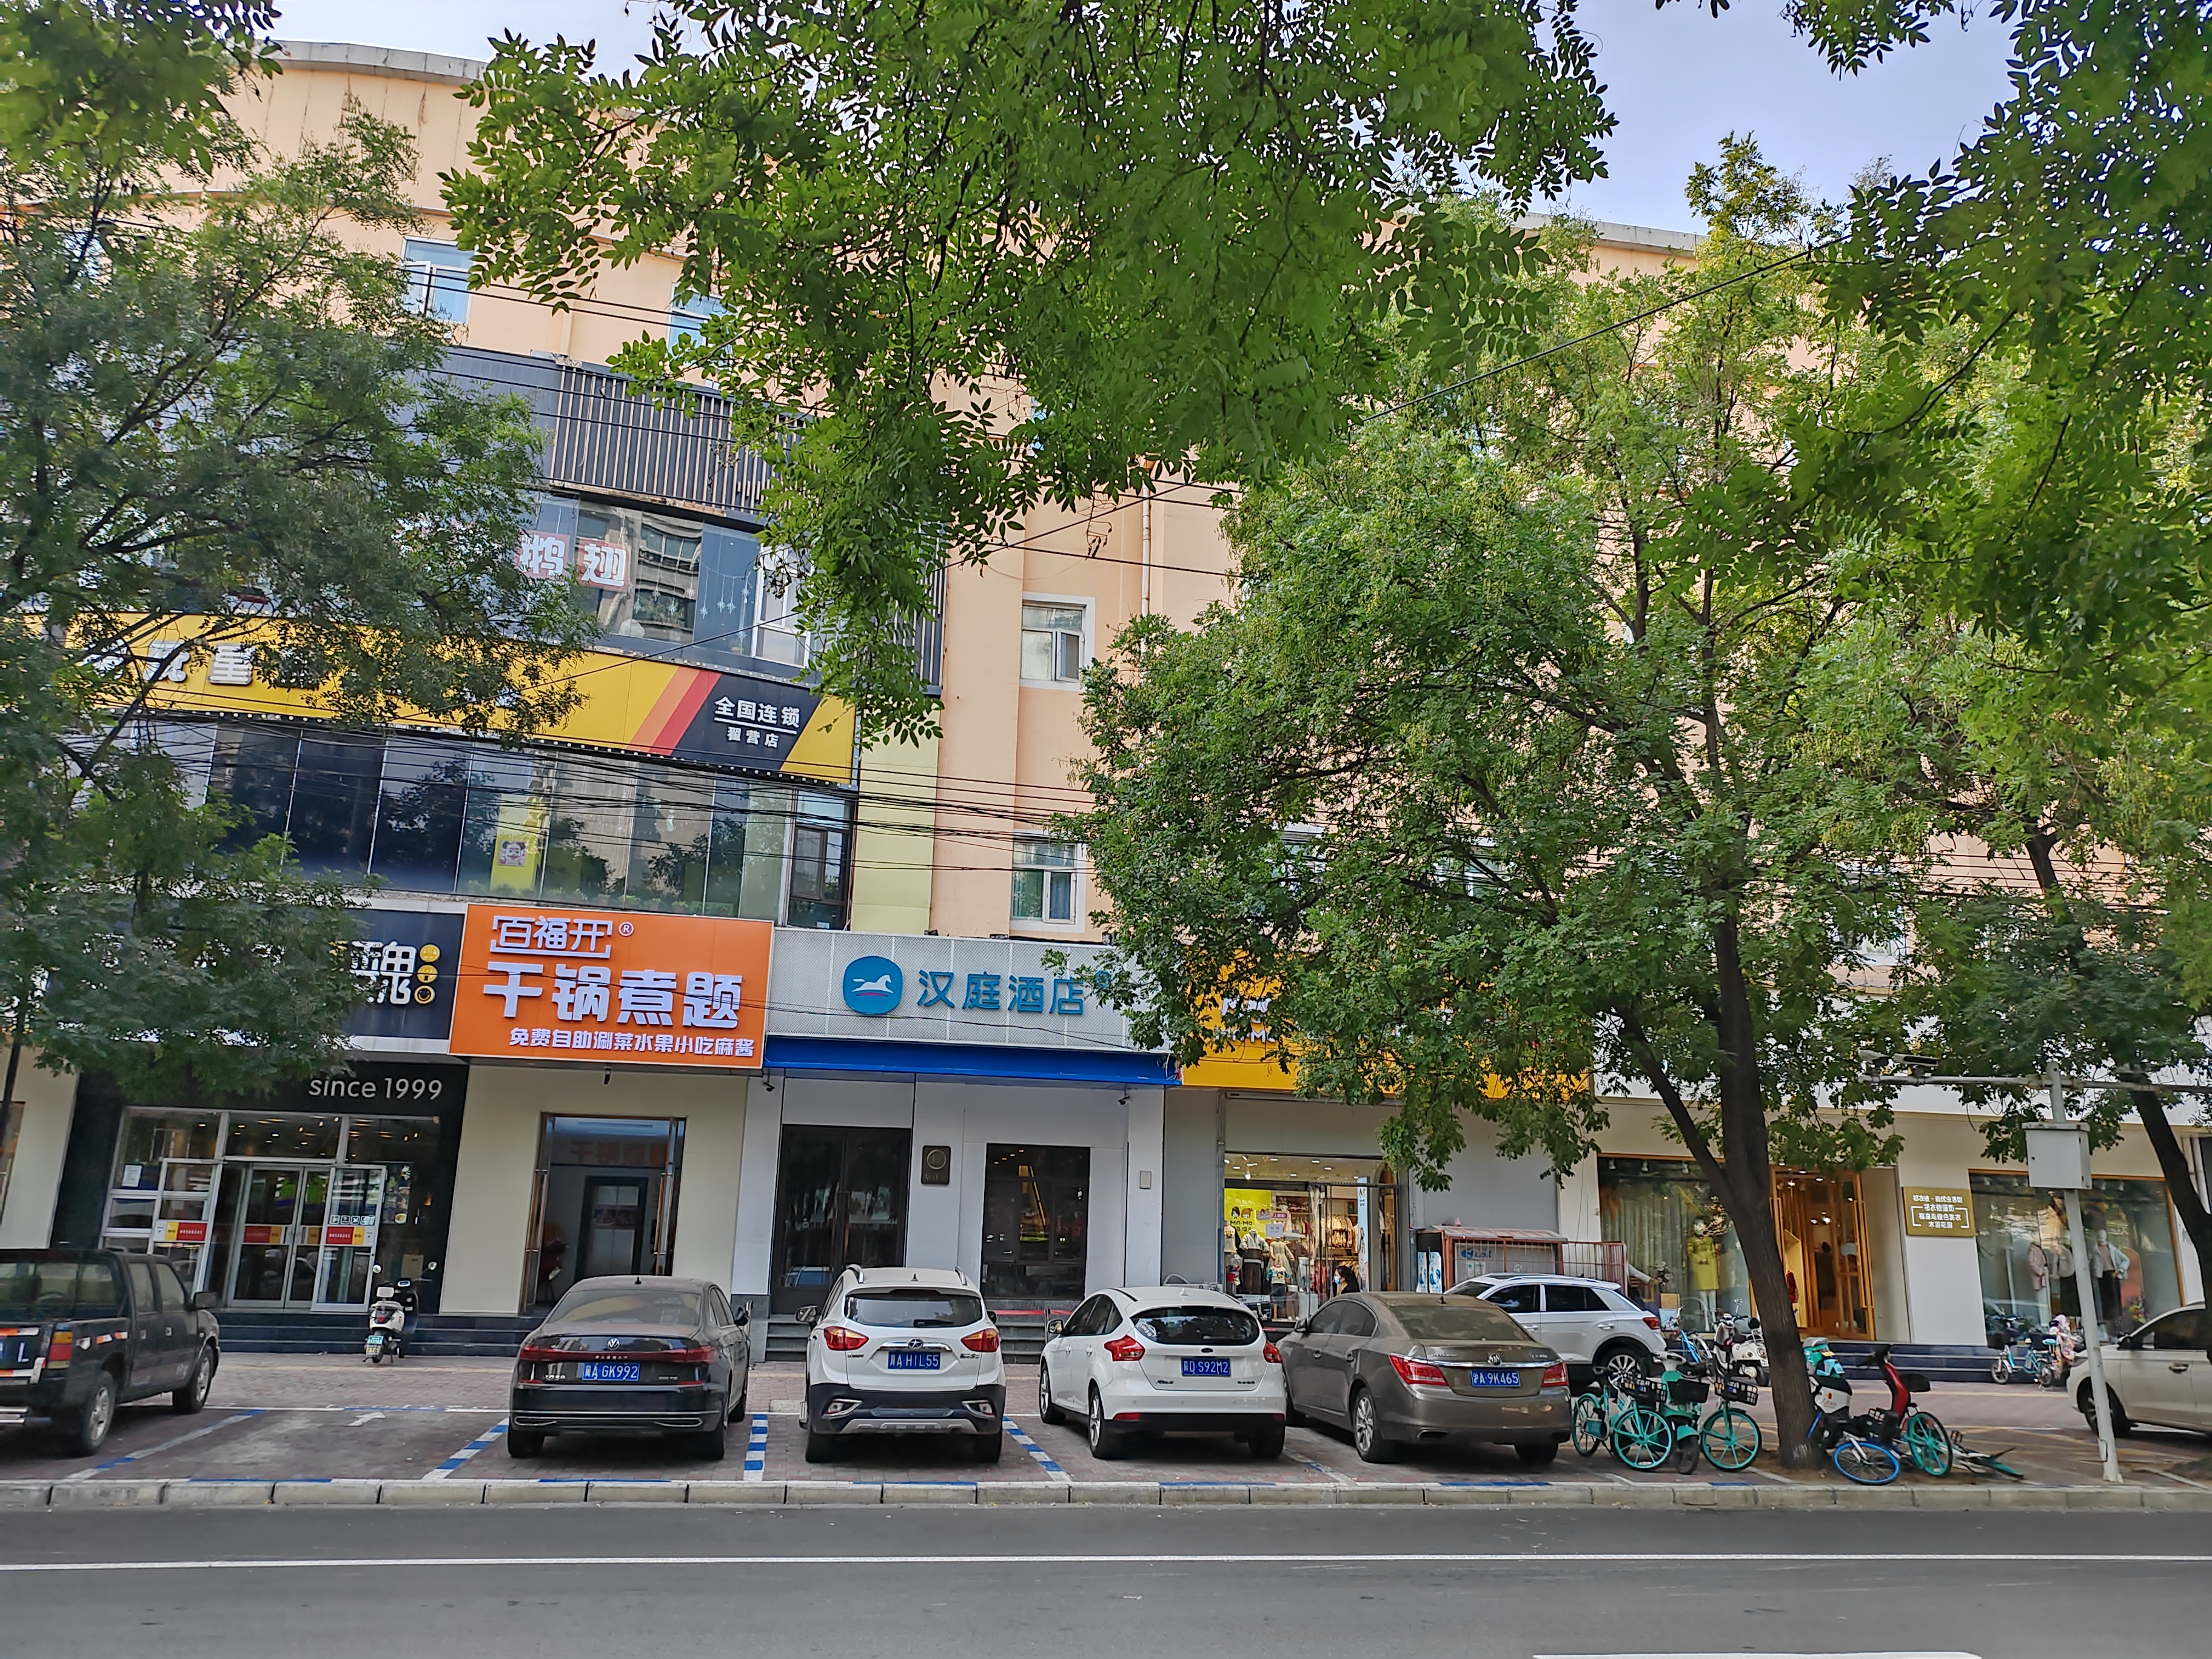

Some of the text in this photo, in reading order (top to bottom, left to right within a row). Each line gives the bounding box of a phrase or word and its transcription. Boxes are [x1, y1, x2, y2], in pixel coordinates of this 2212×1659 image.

[714, 696, 800, 728] 全国连锁
[726, 726, 779, 748] 翟营店
[483, 961, 743, 1029] 干锅煮题
[917, 970, 1084, 1015] 汉庭酒店
[509, 1027, 754, 1057] 免费自助涮菜水果小吃麻酱
[309, 1078, 442, 1100] since 1999
